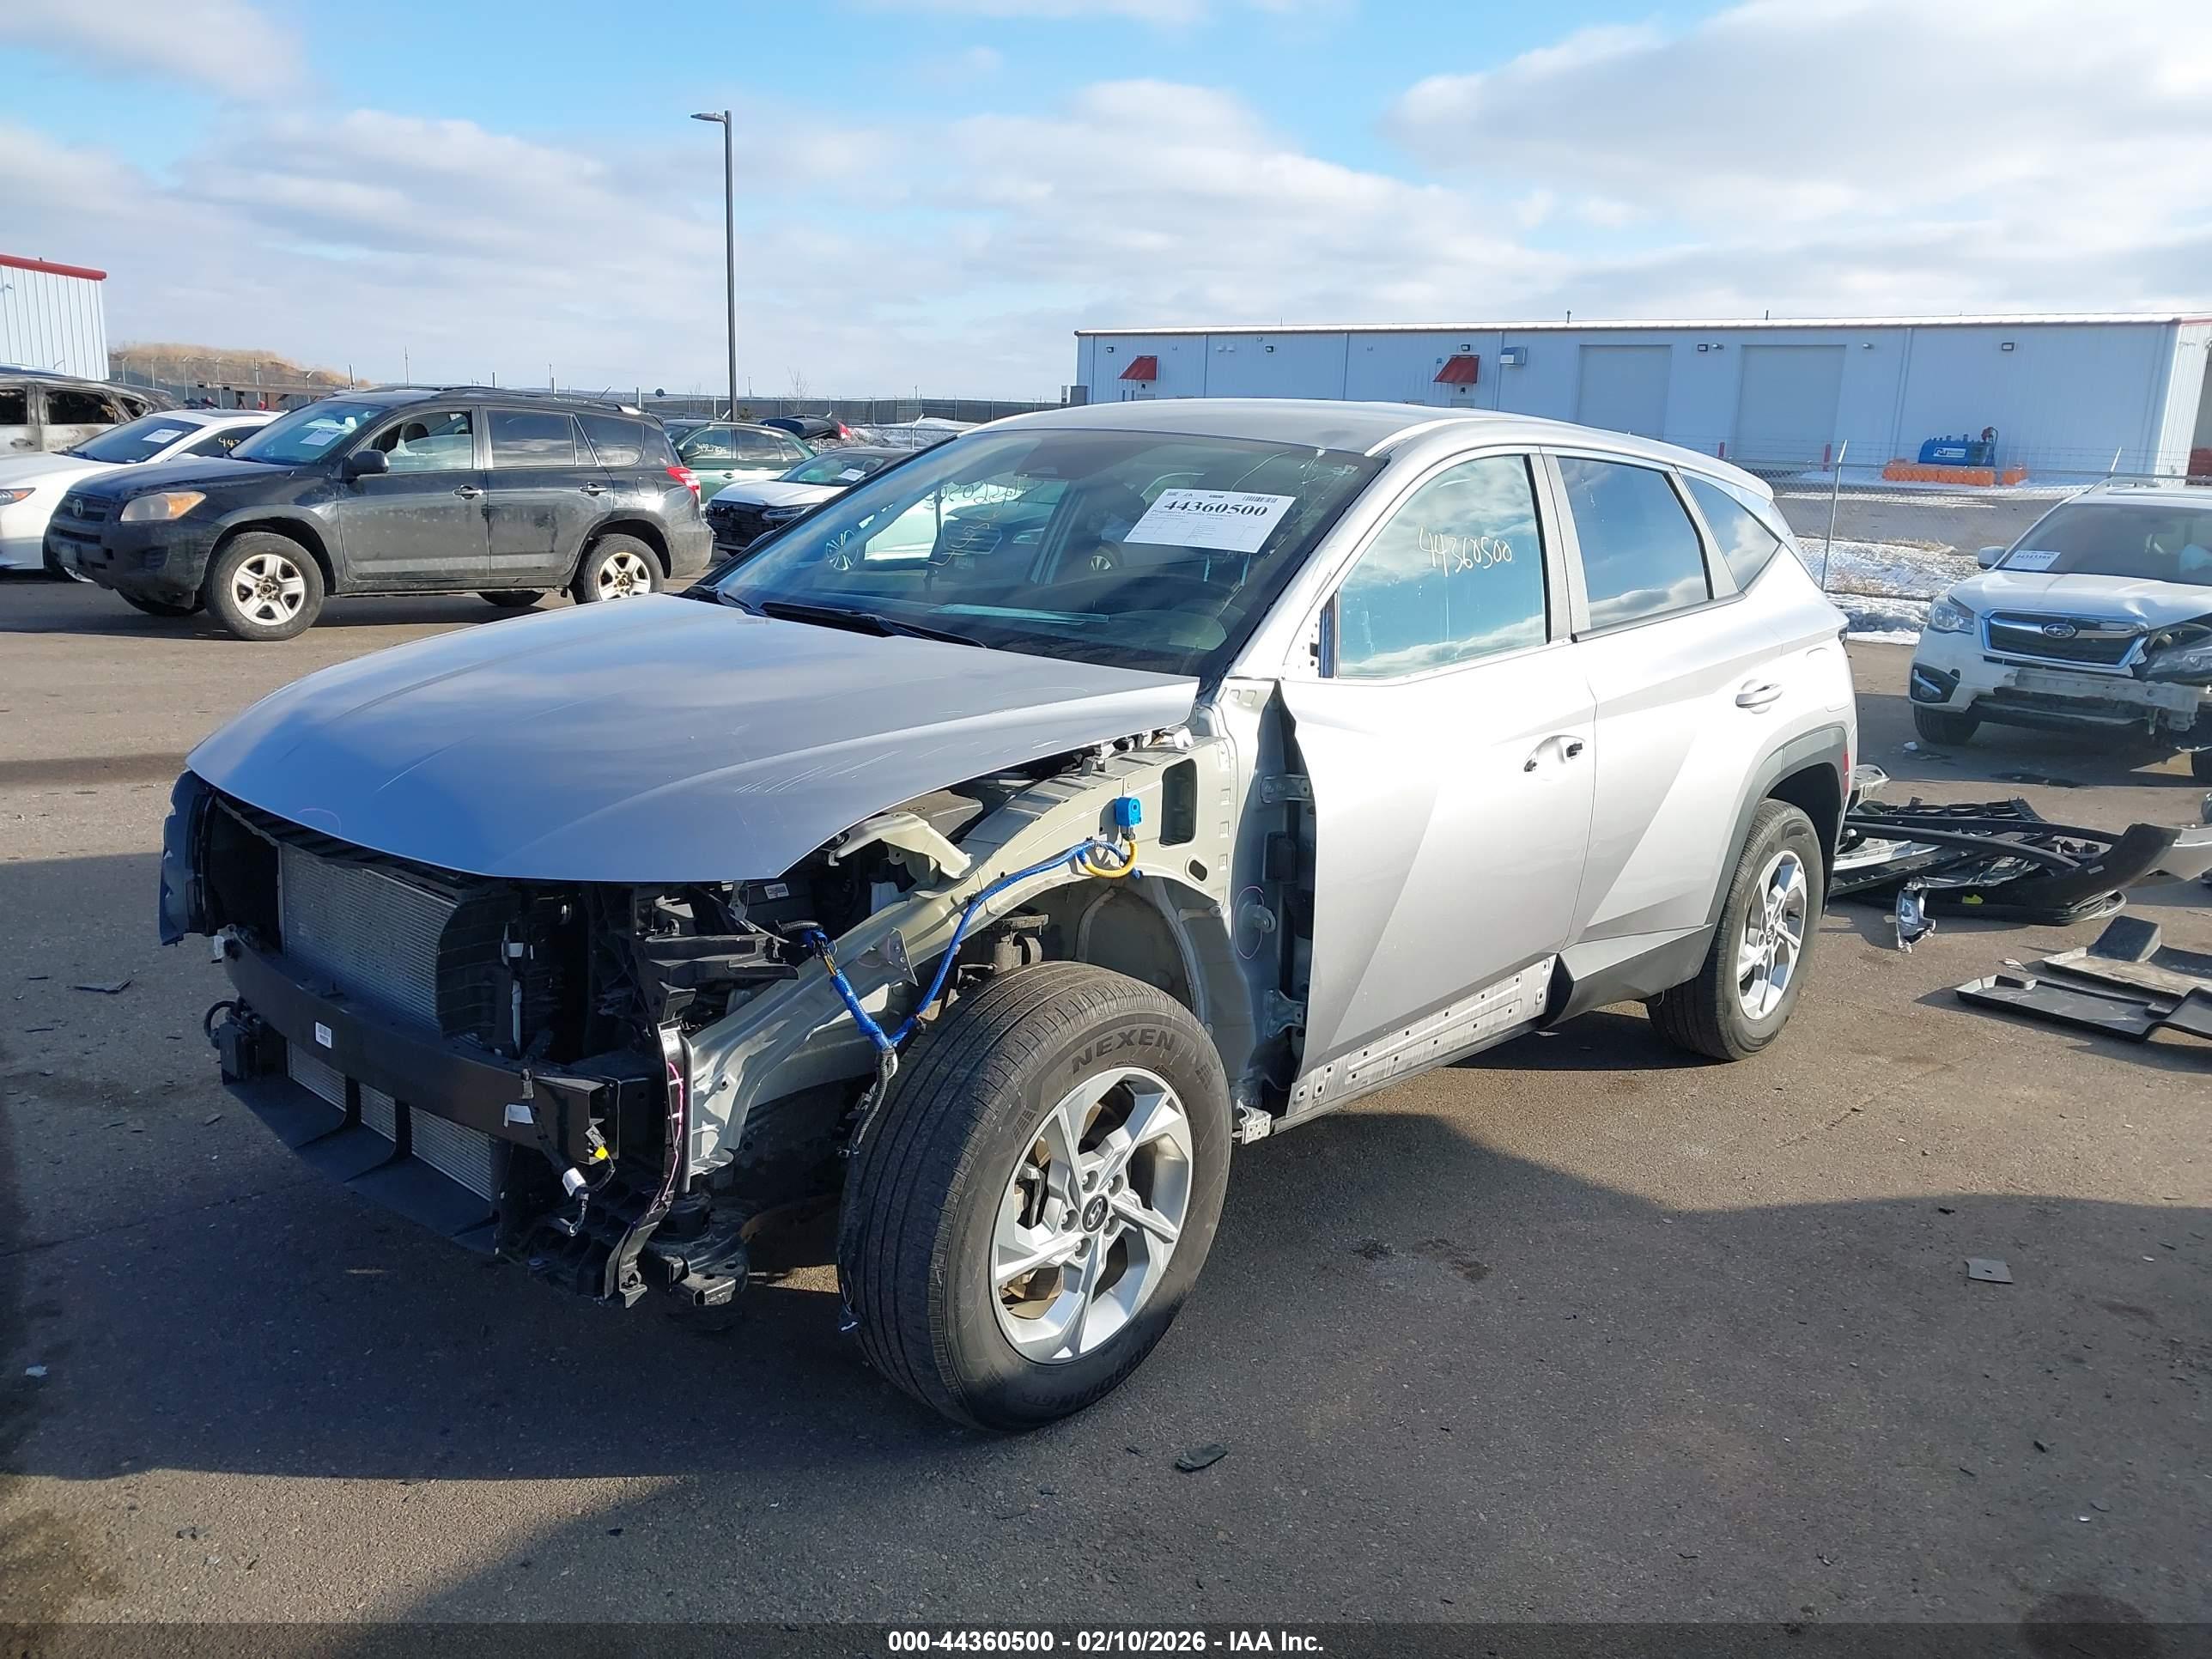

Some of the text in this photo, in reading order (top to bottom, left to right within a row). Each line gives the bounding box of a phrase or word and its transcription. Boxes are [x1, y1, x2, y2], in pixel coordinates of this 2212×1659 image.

[1164, 500, 1268, 517] 44360500
[1419, 526, 1512, 577] 44360500
[1072, 1028, 1176, 1074] NEXEN
